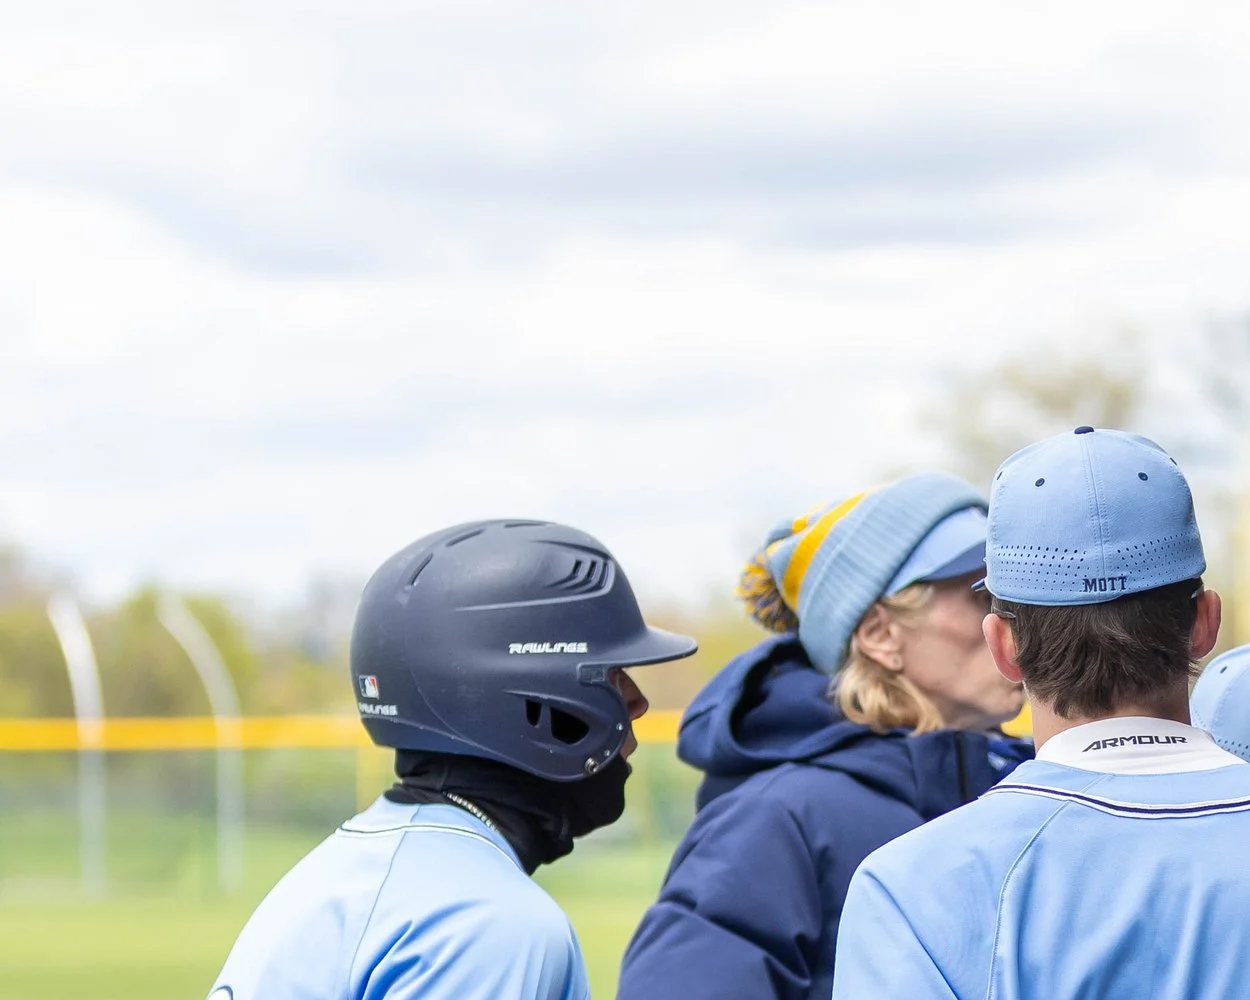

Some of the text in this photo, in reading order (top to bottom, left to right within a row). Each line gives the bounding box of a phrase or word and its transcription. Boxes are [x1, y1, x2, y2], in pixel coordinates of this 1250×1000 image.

[1083, 576, 1128, 593] MOTT
[508, 641, 588, 655] RAWLINGS
[1082, 735, 1188, 763] ARMOUR
